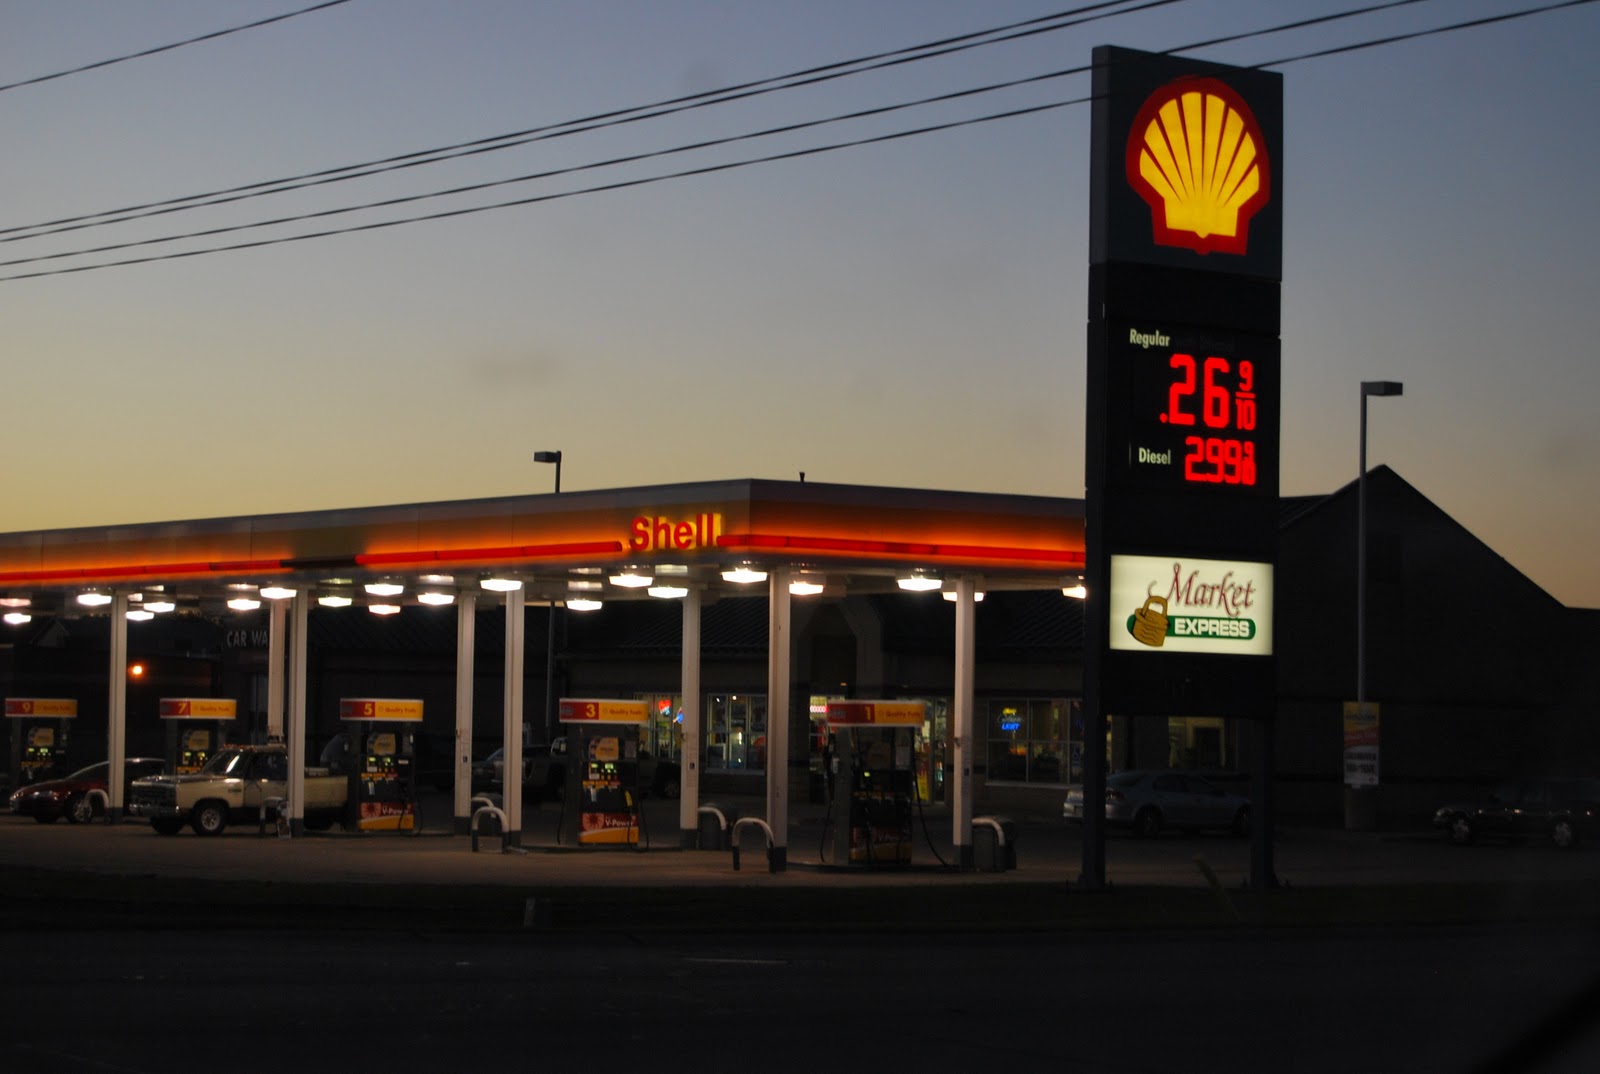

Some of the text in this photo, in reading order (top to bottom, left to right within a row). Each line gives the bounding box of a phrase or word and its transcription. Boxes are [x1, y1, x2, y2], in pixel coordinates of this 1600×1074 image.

[1129, 328, 1170, 349] Regular
[1138, 447, 1171, 465] Diesel
[629, 512, 721, 551] Shell
[1167, 562, 1256, 618] Market
[1174, 618, 1250, 637] EXPRESS
[226, 630, 268, 647] CAR WA
[22, 701, 31, 713] 9
[178, 702, 187, 715] 7
[363, 703, 373, 716] 5
[586, 703, 596, 718] 3
[864, 705, 872, 721] 1
